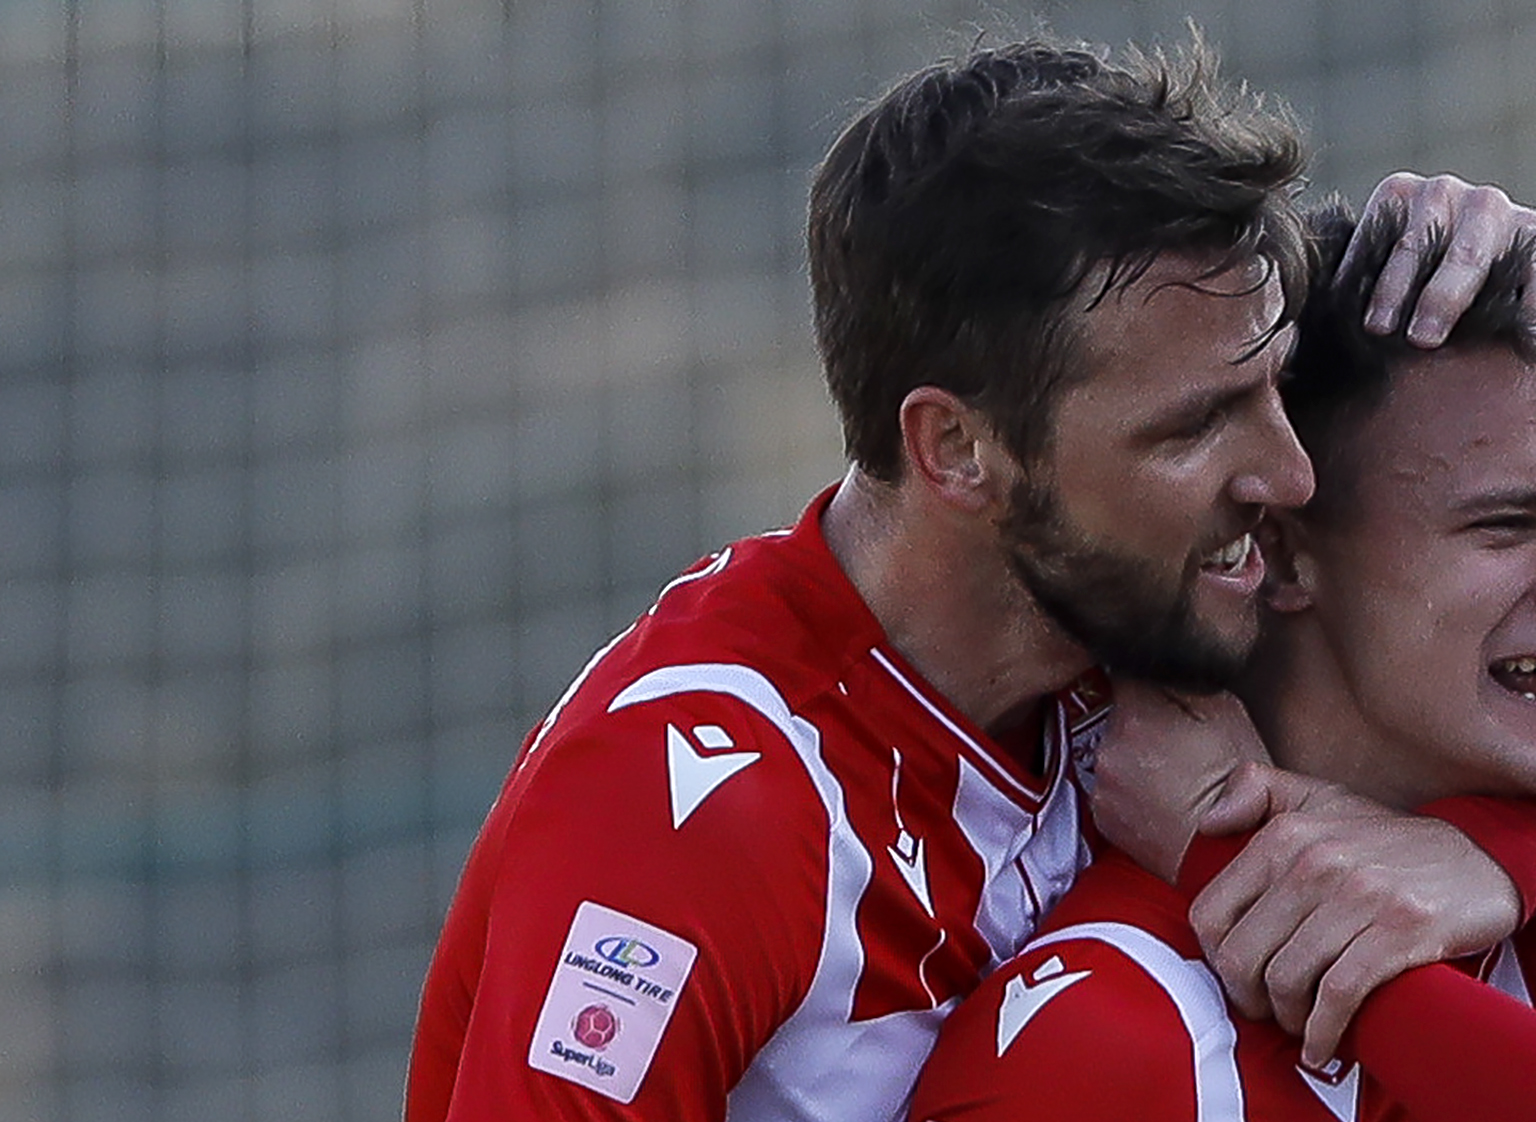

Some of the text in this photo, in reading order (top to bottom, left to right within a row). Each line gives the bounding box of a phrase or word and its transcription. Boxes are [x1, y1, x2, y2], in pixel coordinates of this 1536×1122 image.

[563, 951, 675, 1004] LINGLONG TIRE
[550, 1040, 616, 1077] SuperLiga
